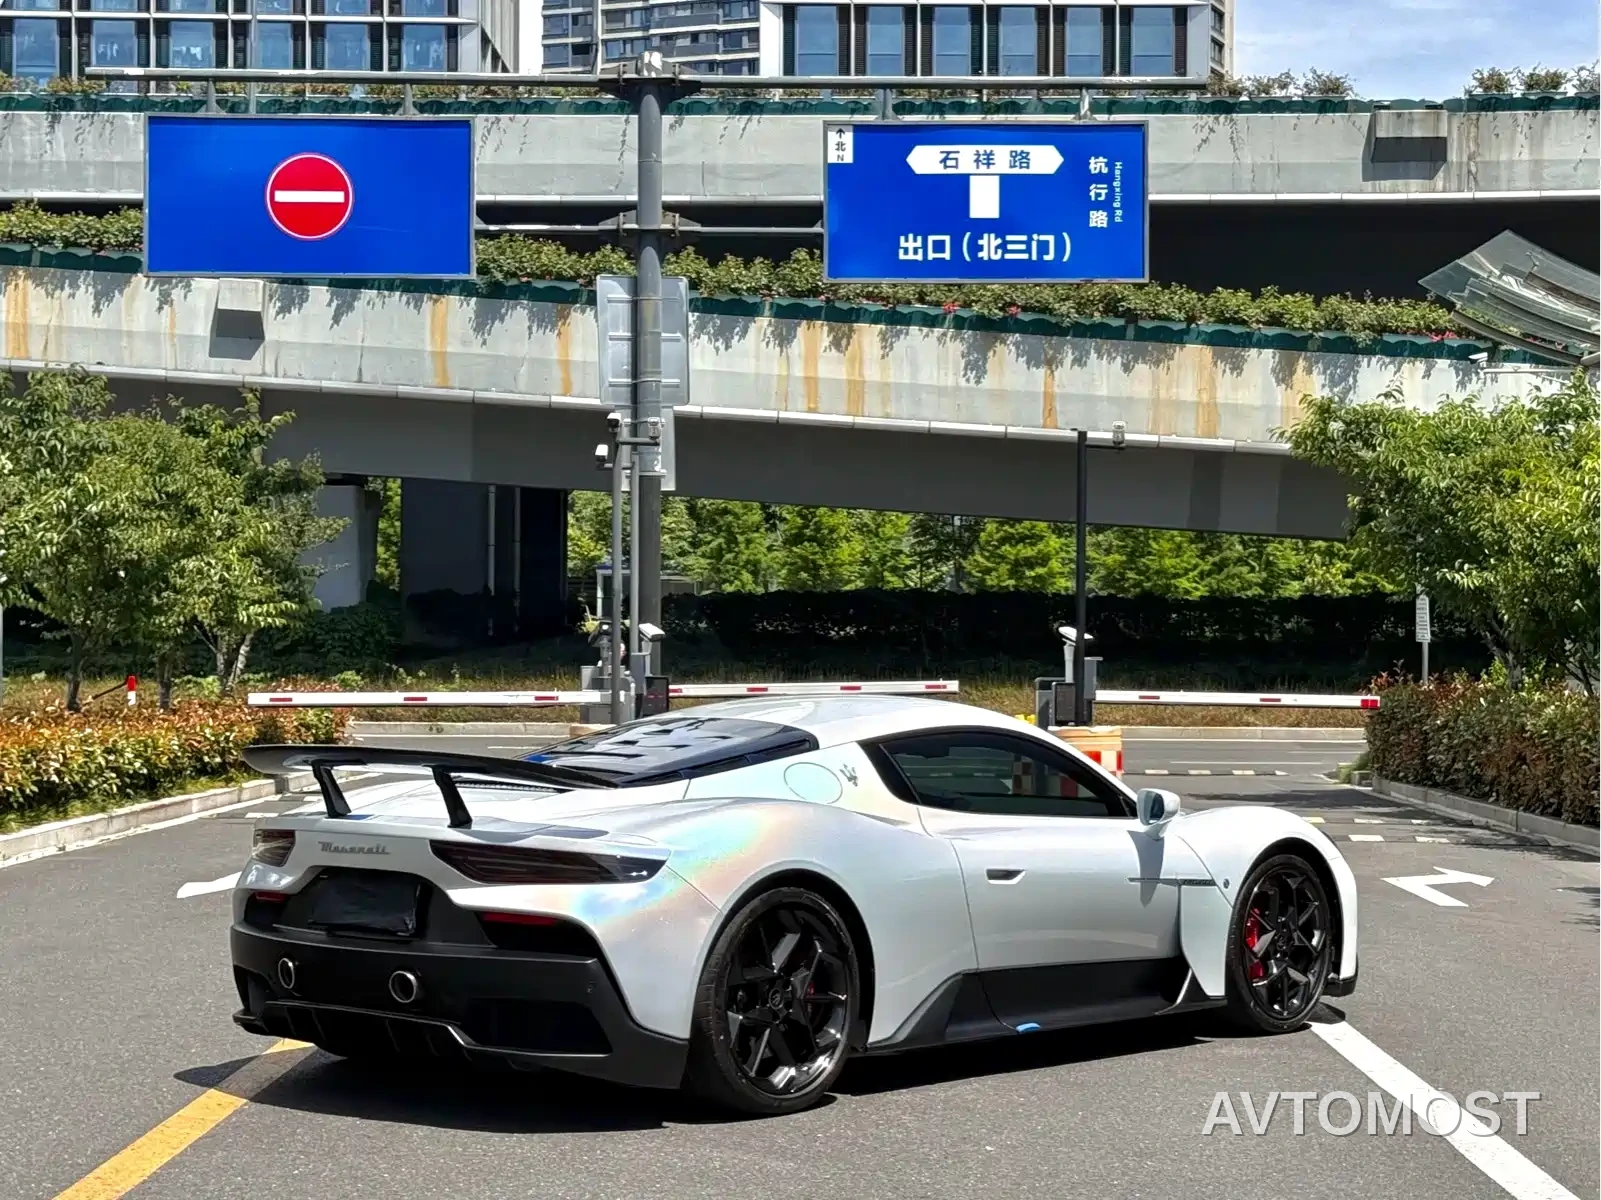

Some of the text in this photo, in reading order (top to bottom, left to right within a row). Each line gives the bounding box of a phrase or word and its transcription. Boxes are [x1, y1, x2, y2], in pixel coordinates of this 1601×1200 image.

[835, 141, 846, 152] 北
[836, 154, 844, 162] N
[939, 150, 1031, 170] 石祥路
[1089, 156, 1108, 228] 杭行路
[1113, 162, 1123, 223] Hangxing Rd
